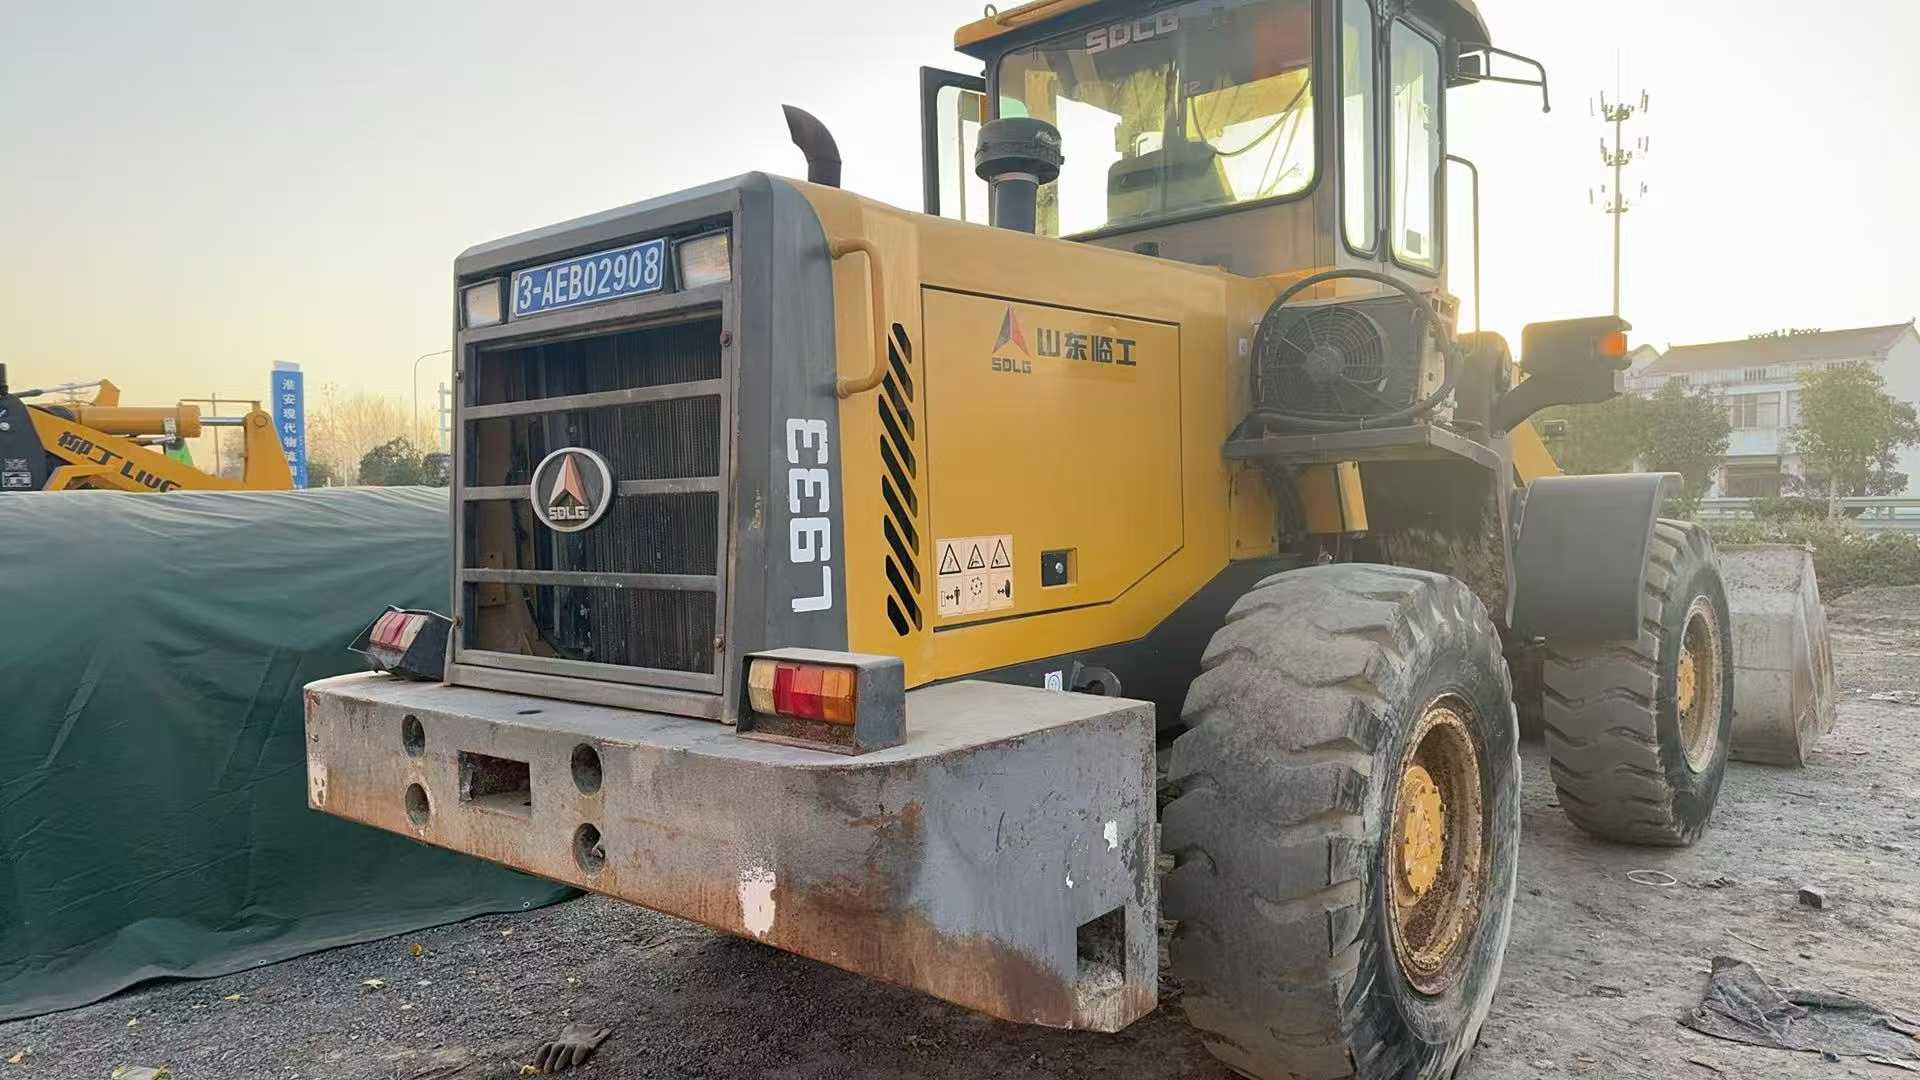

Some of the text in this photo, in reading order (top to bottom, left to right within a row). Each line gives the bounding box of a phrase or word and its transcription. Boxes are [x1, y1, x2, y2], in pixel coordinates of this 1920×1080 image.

[1086, 13, 1180, 55] SDLG
[519, 247, 660, 309] 3-AEB02908
[991, 357, 1032, 374] SDLG
[1037, 328, 1136, 366] 山东临工
[57, 431, 123, 465] 柳工
[548, 505, 589, 520] SDLG
[786, 418, 832, 613] L933
